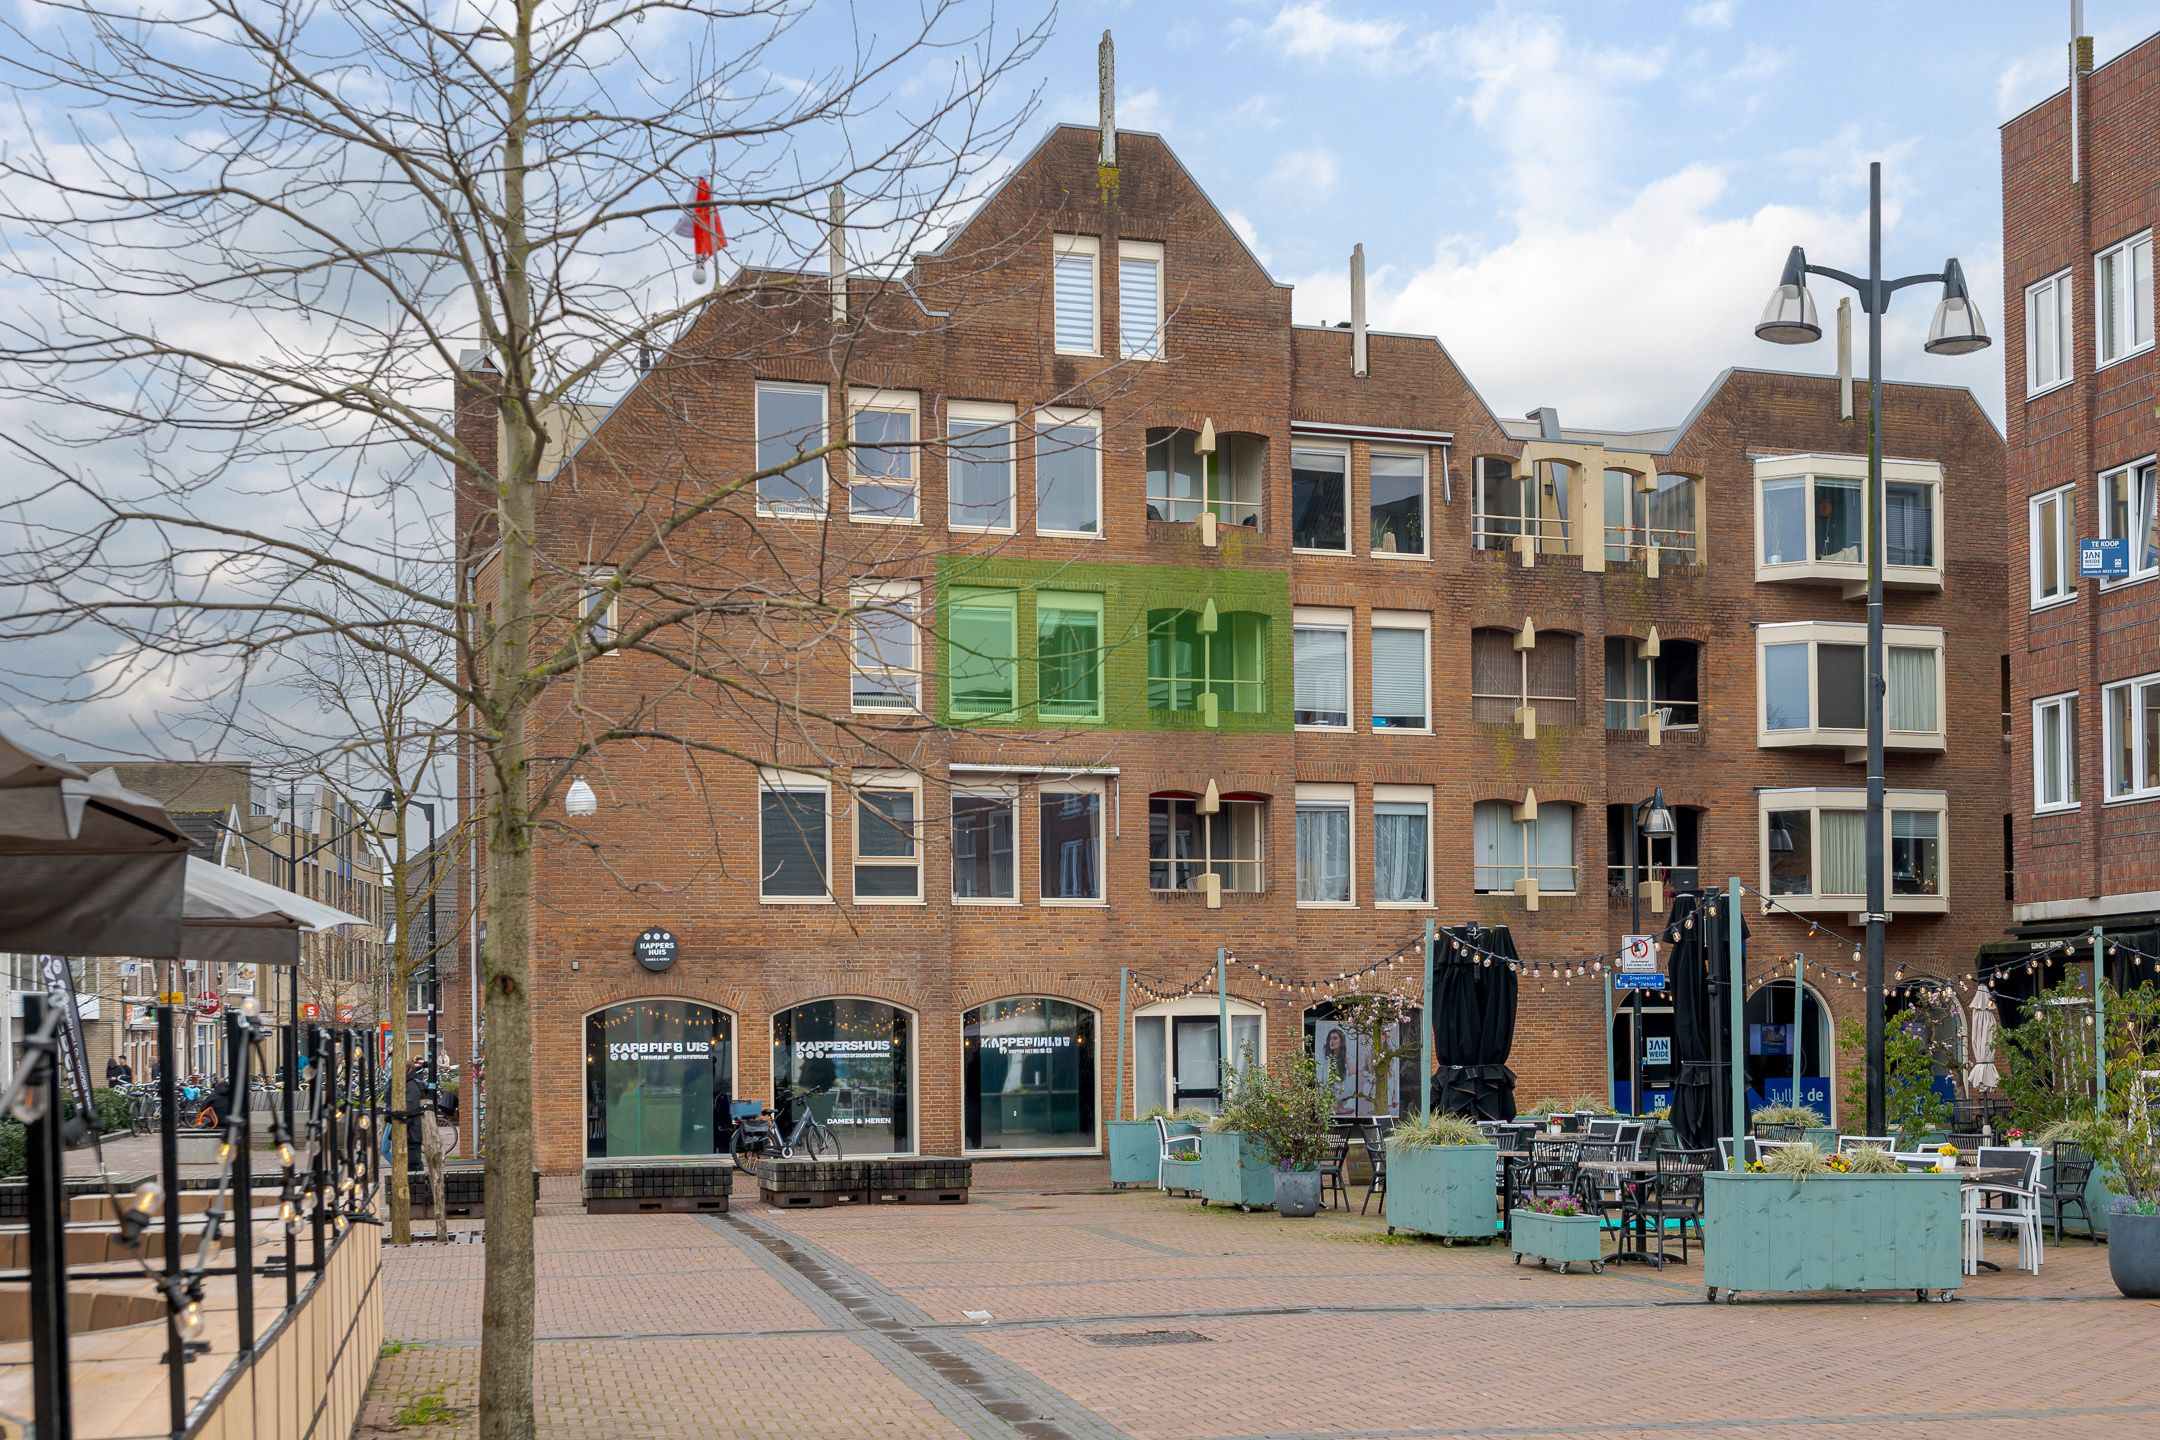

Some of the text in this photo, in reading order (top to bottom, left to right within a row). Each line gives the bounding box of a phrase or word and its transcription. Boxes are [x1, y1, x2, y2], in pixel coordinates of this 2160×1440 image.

[796, 1041, 890, 1051] KAPPERSHUIS
[1649, 1040, 1668, 1050] JAN
[1771, 1088, 1823, 1102] Julle de
